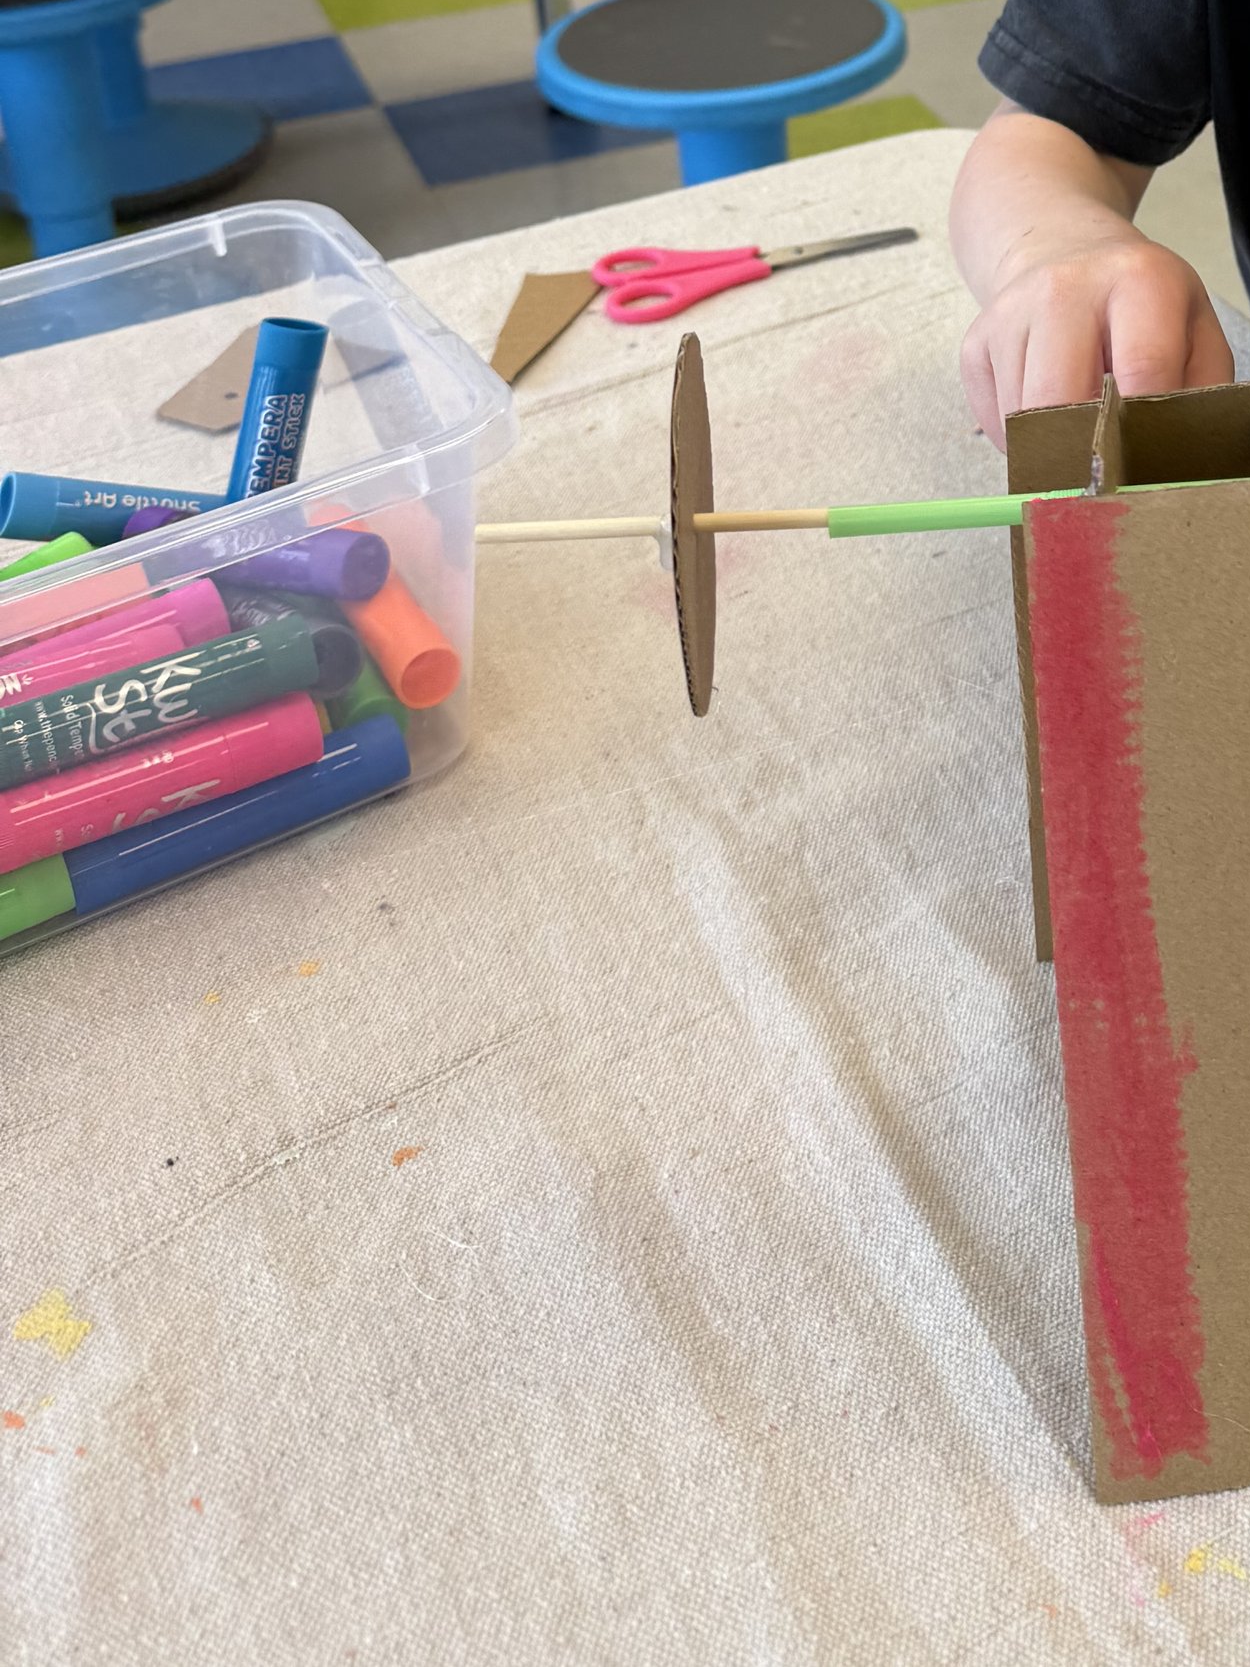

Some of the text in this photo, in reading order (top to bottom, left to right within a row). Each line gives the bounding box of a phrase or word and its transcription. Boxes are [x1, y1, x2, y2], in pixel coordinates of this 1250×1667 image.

[273, 393, 306, 487] INT STICK
[84, 490, 118, 508] Art
[94, 679, 153, 743] St
[139, 650, 202, 723] Kw
[69, 721, 85, 761] Tempe
